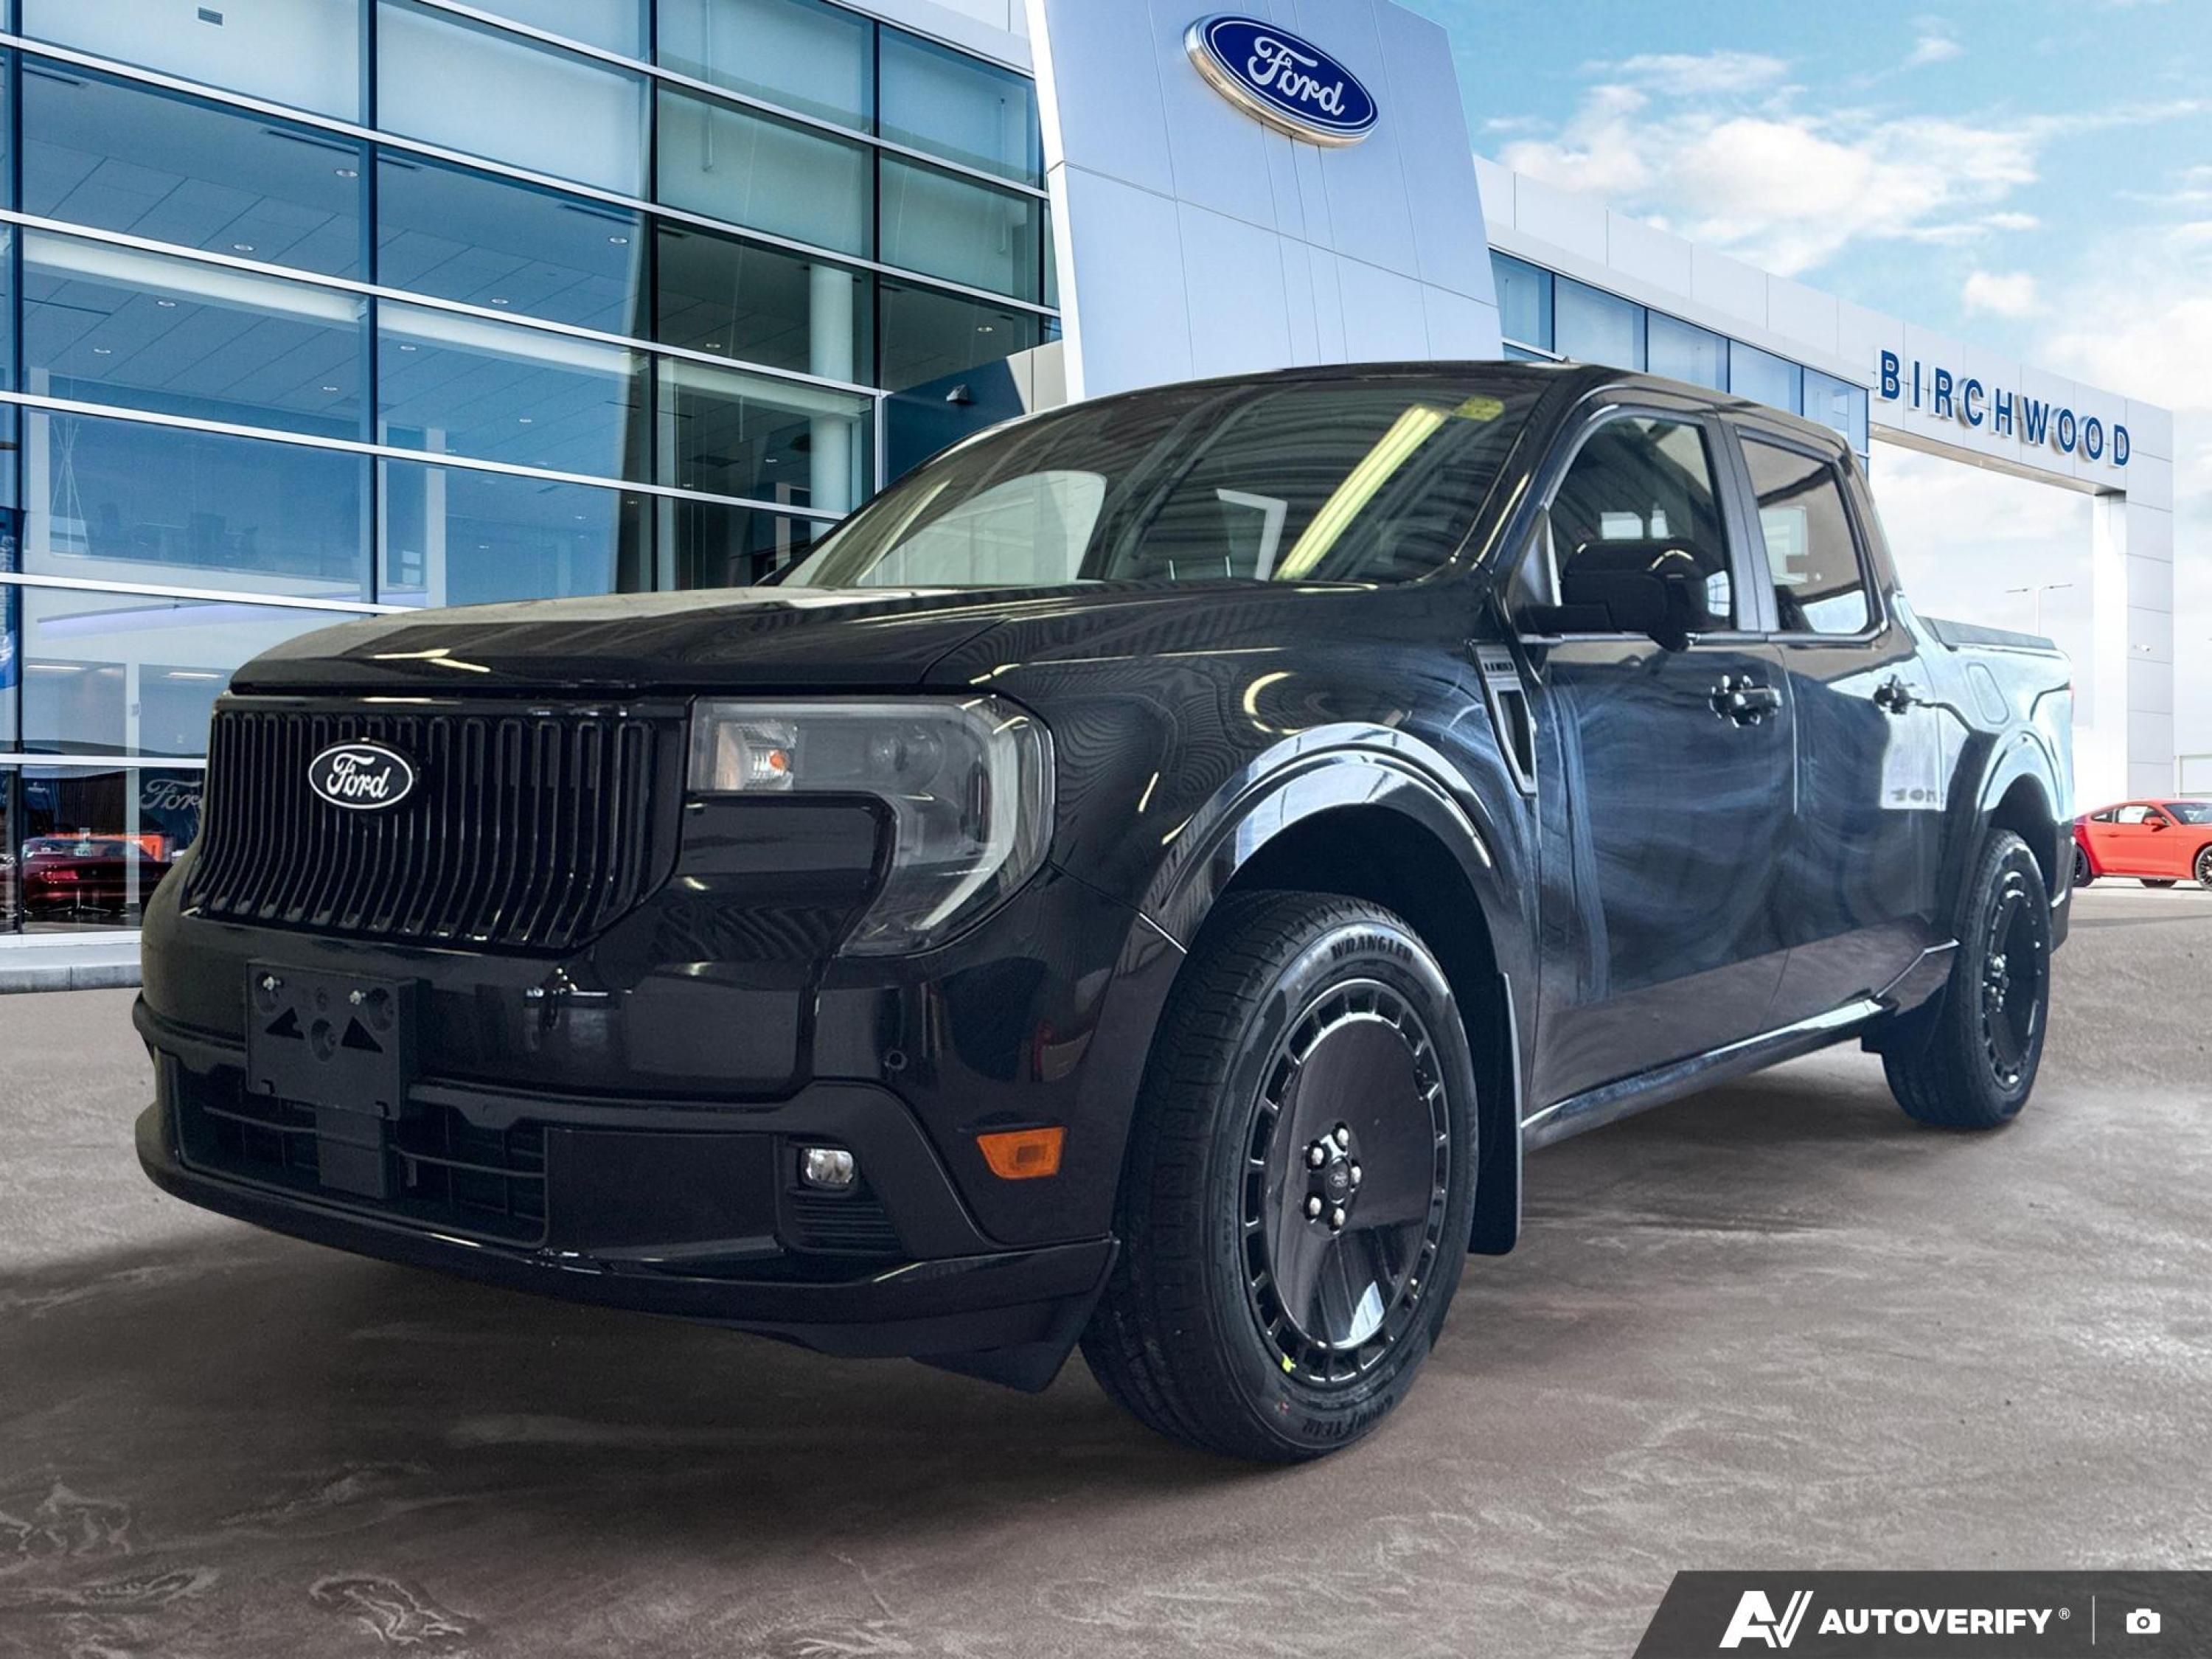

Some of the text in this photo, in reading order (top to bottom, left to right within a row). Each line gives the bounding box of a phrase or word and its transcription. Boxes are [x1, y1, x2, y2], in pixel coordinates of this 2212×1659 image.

[1248, 36, 1346, 116] Ford
[1879, 348, 2131, 467] BIRCHWOOD
[140, 778, 204, 810] For
[326, 753, 392, 799] Ford
[1331, 935, 1413, 961] WRANGLER
